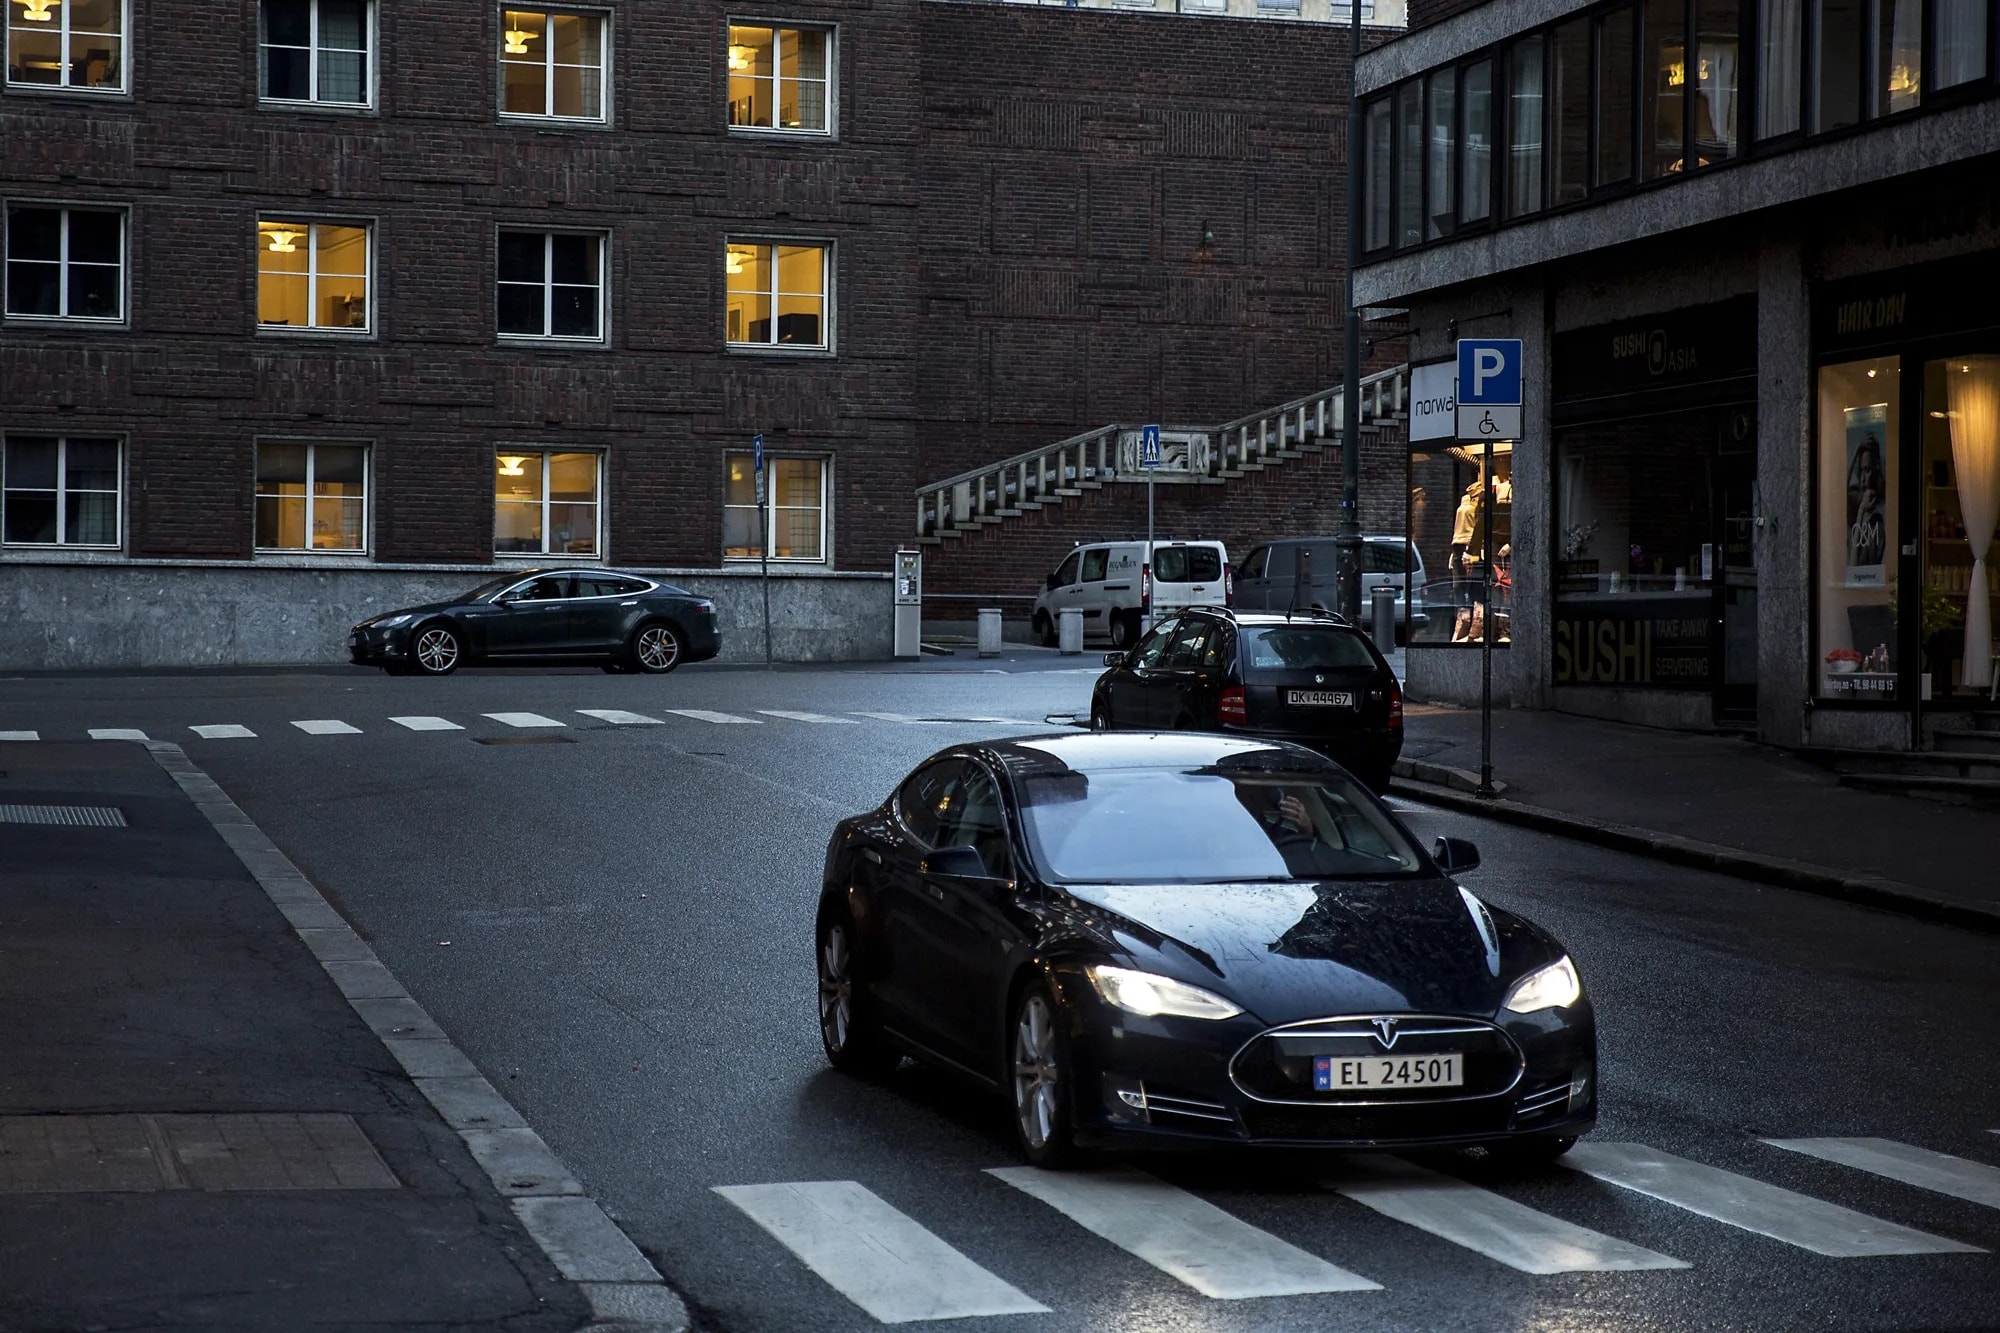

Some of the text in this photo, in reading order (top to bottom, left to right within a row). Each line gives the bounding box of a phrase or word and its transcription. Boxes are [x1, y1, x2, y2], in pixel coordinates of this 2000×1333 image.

[1875, 292, 1907, 328] DAY
[1612, 331, 1647, 360] SUSHI
[1474, 348, 1505, 397] P
[1667, 347, 1698, 372] ASIA
[1415, 396, 1453, 416] norwa
[755, 440, 761, 468] P
[1851, 520, 1879, 547] O&M
[1655, 617, 1709, 639] TAKE AWAY
[1555, 618, 1651, 682] SUSHI
[1655, 657, 1709, 677] SERVERING
[1291, 691, 1349, 704] DK 44467
[1319, 1076, 1327, 1085] N
[1341, 1059, 1453, 1085] EL 24501
